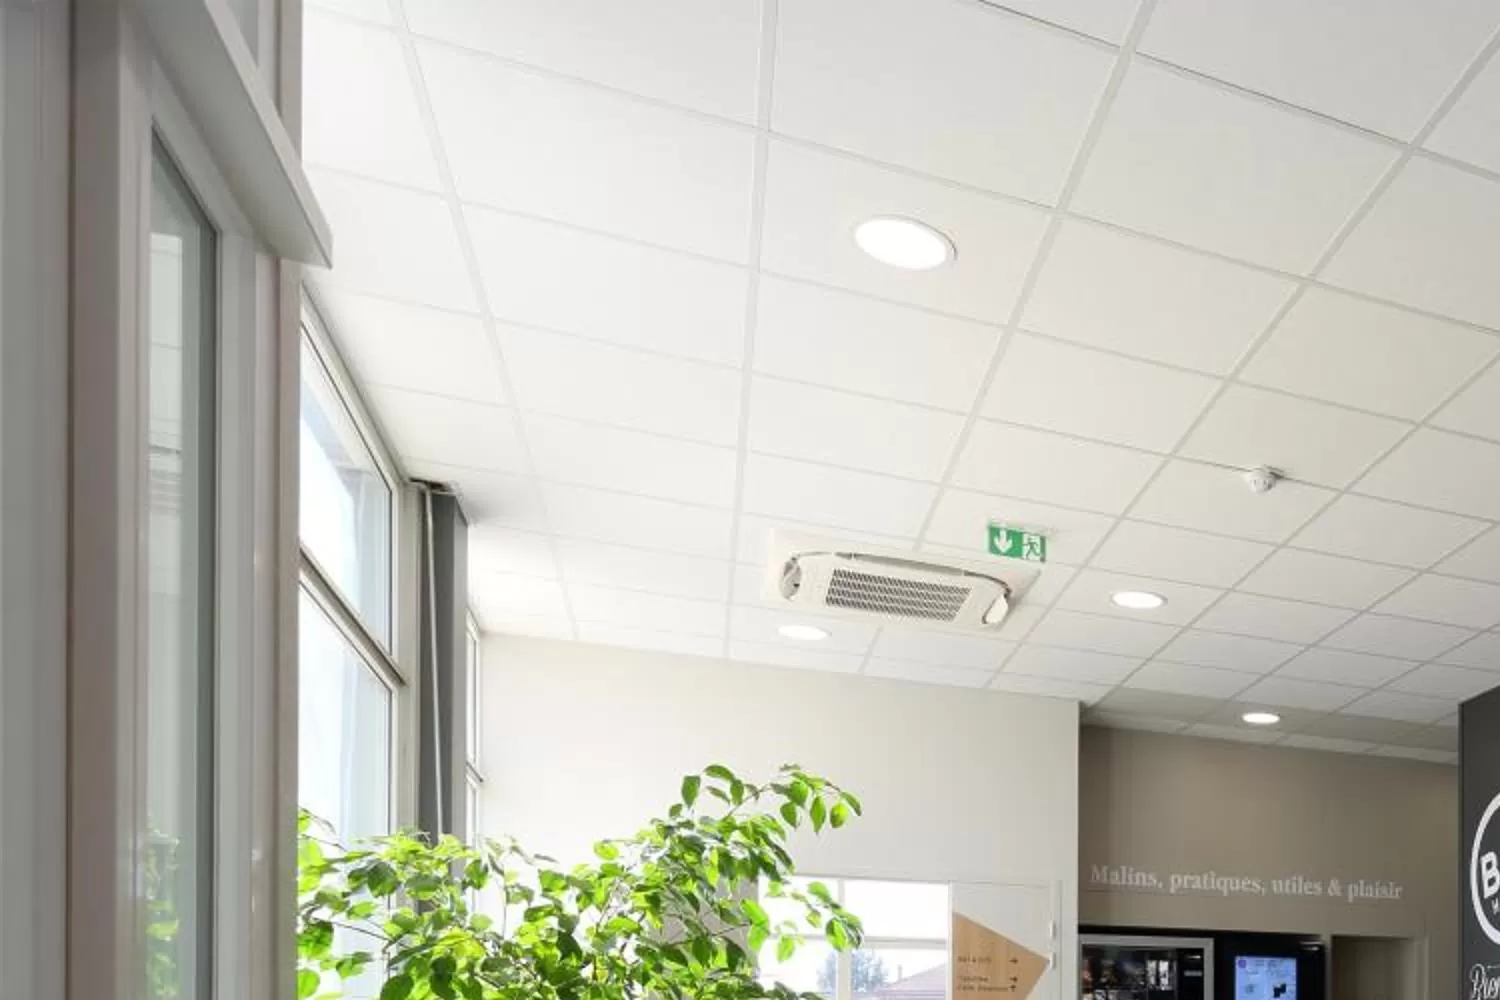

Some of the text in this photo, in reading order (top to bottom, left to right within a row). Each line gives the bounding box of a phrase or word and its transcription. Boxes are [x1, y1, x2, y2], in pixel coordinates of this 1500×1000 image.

[1090, 863, 1403, 903] Malins, pratiques, utiles & plaisir
